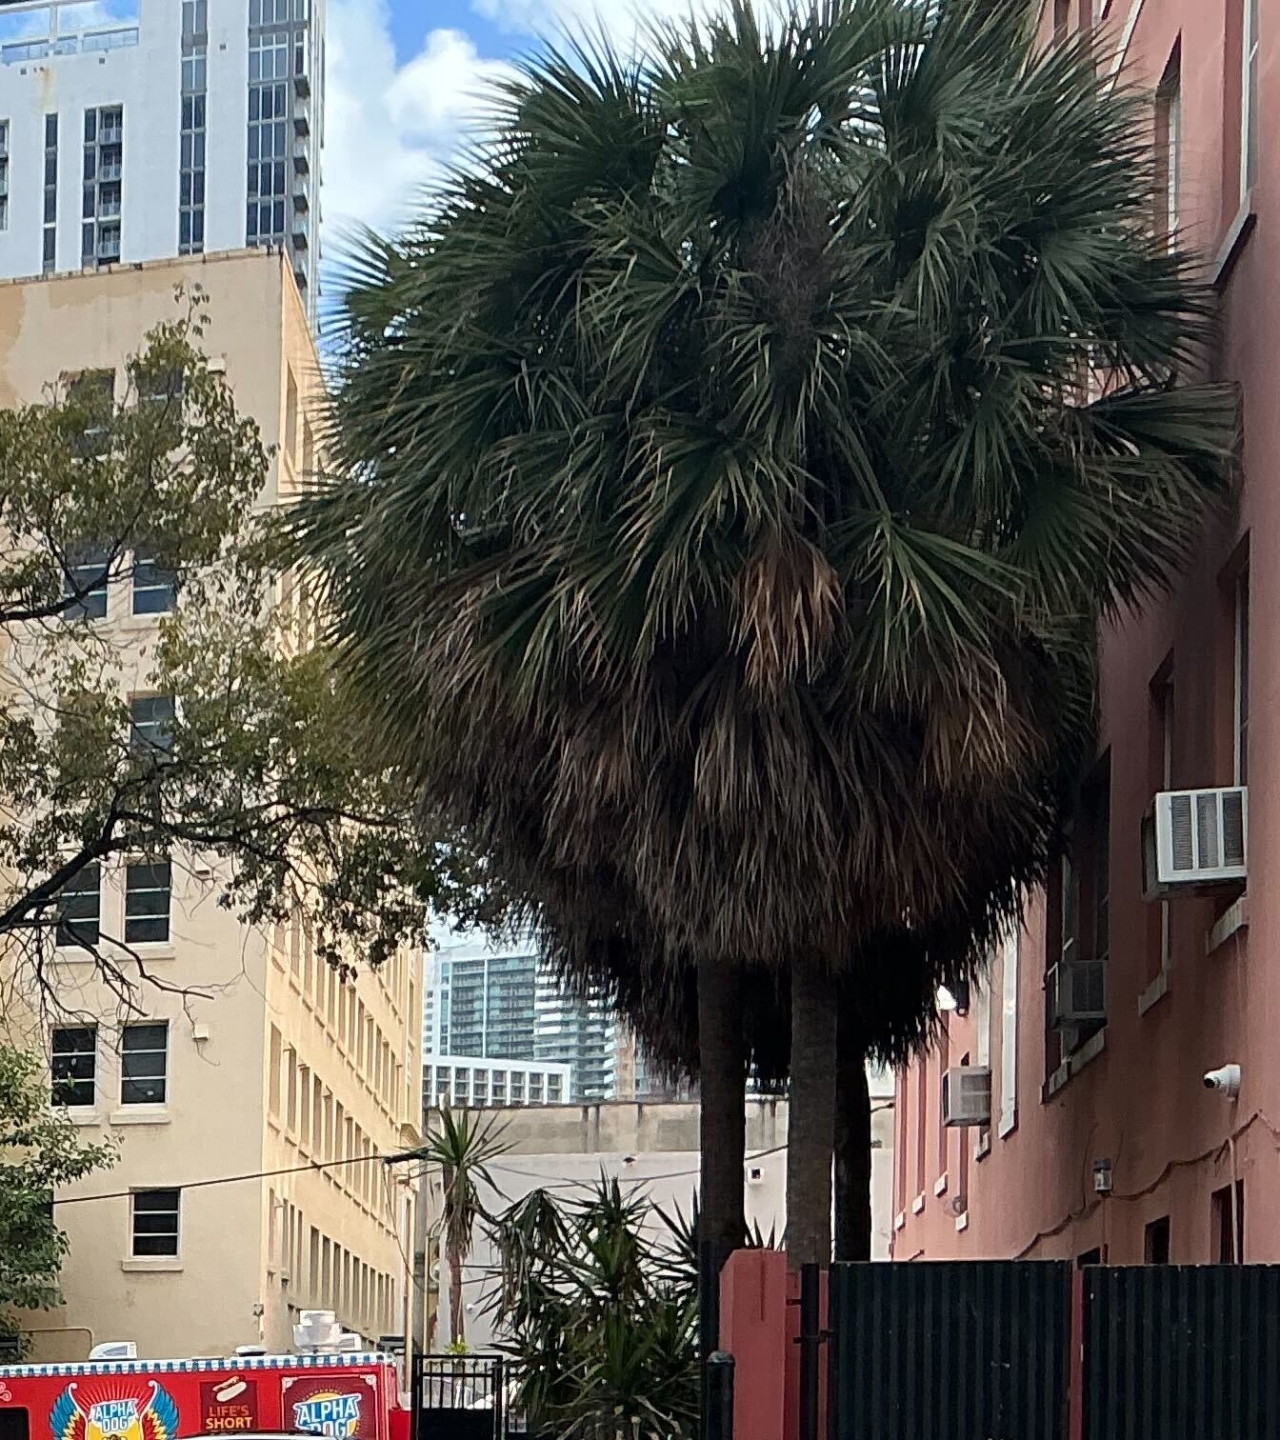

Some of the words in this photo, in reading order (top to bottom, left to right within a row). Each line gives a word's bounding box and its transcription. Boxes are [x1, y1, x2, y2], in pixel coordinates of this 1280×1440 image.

[94, 1402, 136, 1419] ALPHA
[208, 1404, 250, 1418] LIFE'S
[299, 1399, 358, 1424] ALPHA
[102, 1416, 129, 1432] DOG
[205, 1416, 253, 1430] SHORT
